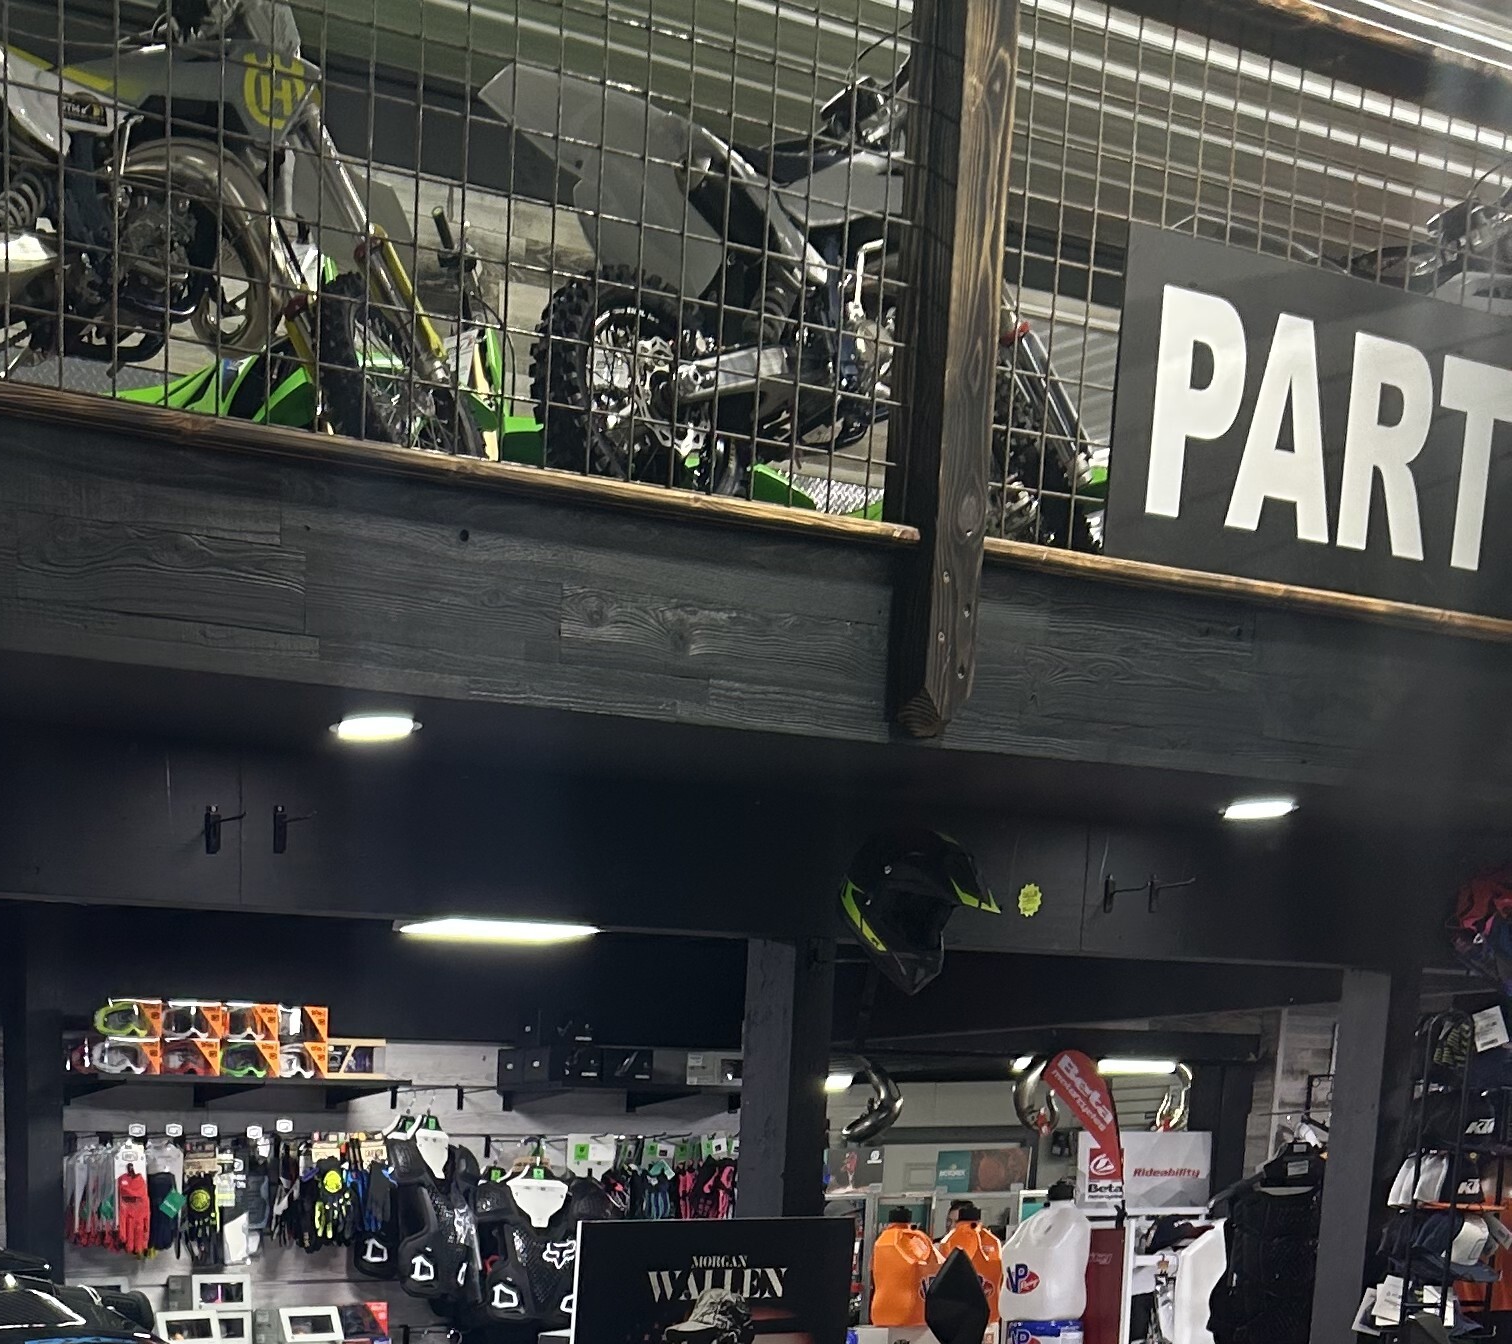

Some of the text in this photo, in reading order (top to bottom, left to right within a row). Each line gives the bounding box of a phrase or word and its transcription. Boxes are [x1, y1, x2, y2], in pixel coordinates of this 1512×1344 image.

[1057, 1054, 1114, 1126] Beta
[1133, 1167, 1201, 1178] Rideability
[1088, 1183, 1123, 1193] Beta
[691, 1255, 748, 1269] MORGAN
[648, 1267, 788, 1303] WALLEN
